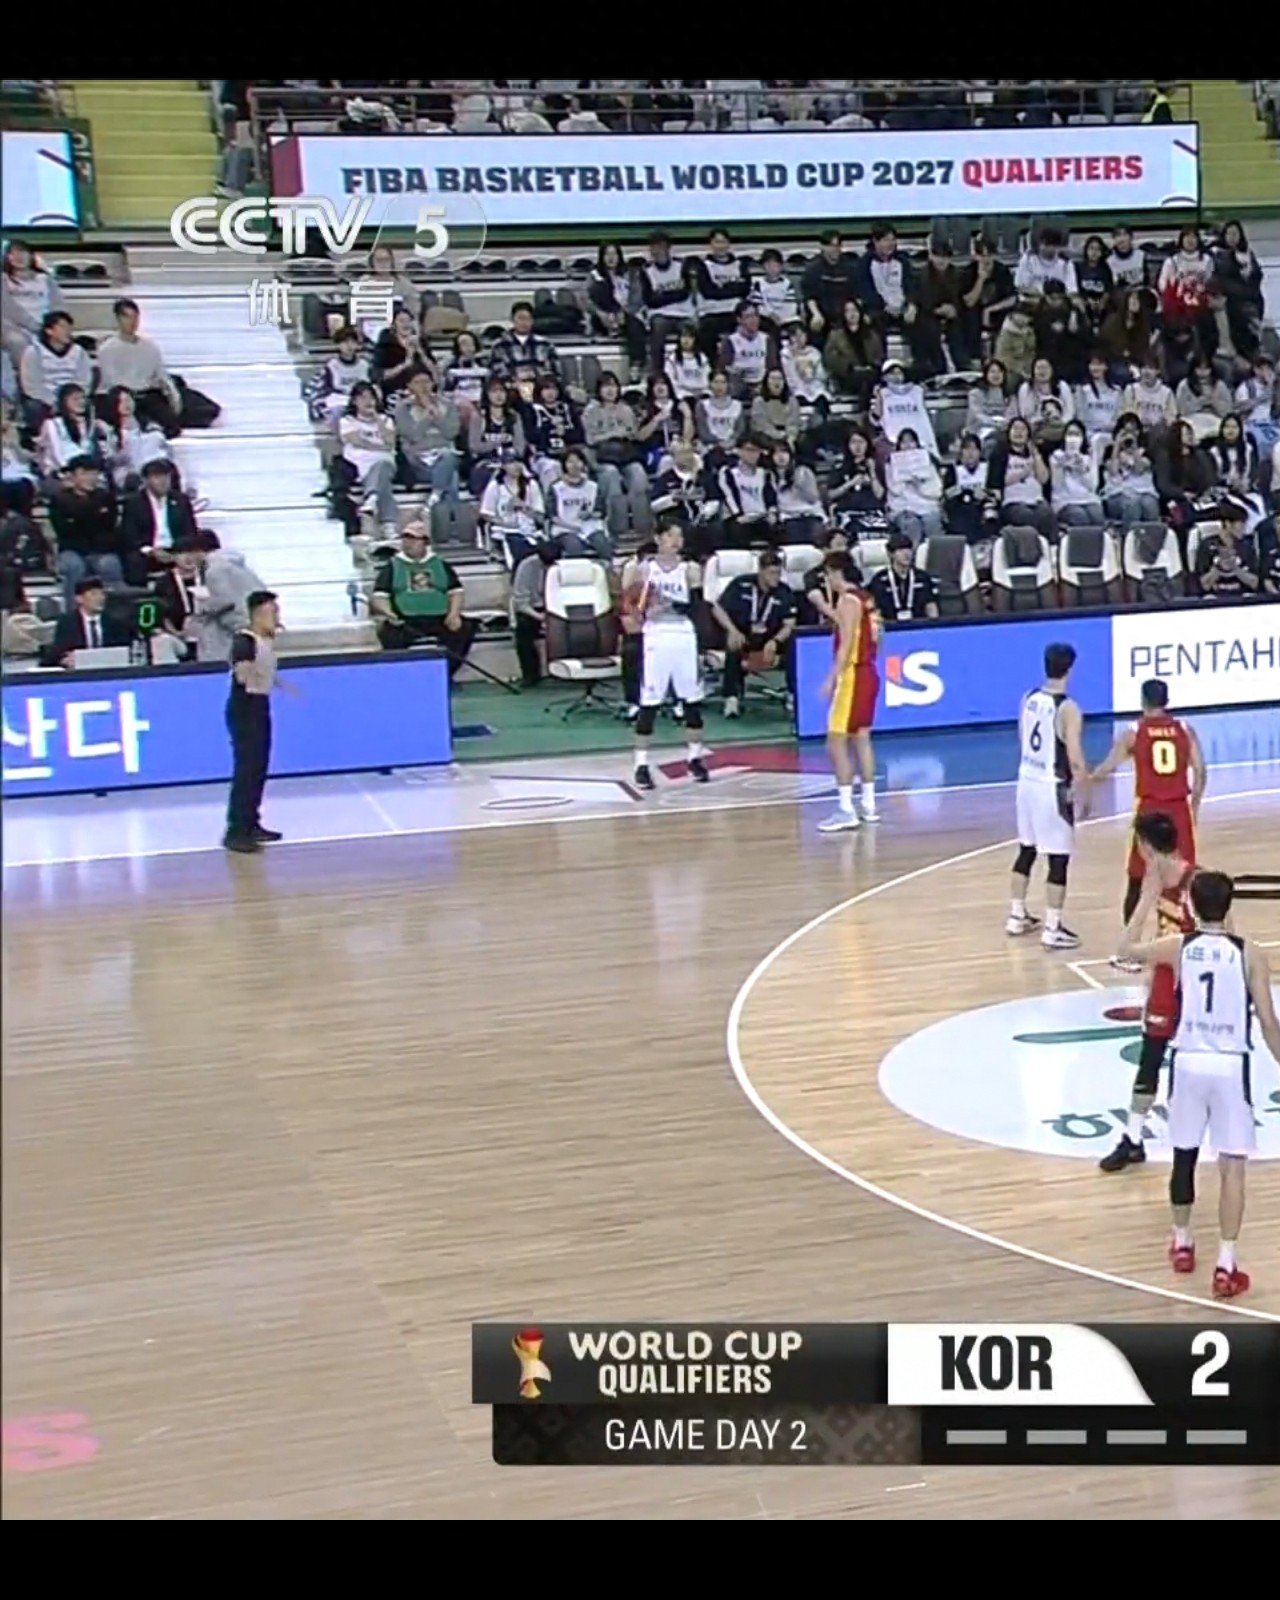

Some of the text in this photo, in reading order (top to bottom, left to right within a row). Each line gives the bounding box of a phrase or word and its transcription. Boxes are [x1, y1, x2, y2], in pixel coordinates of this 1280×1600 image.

[340, 155, 1143, 194] FIBA BASKETBALL WORLD CUP 2027 QUALIFIERS
[1029, 721, 1042, 752] 6
[1151, 739, 1177, 775] 0
[1198, 971, 1215, 1014] 1
